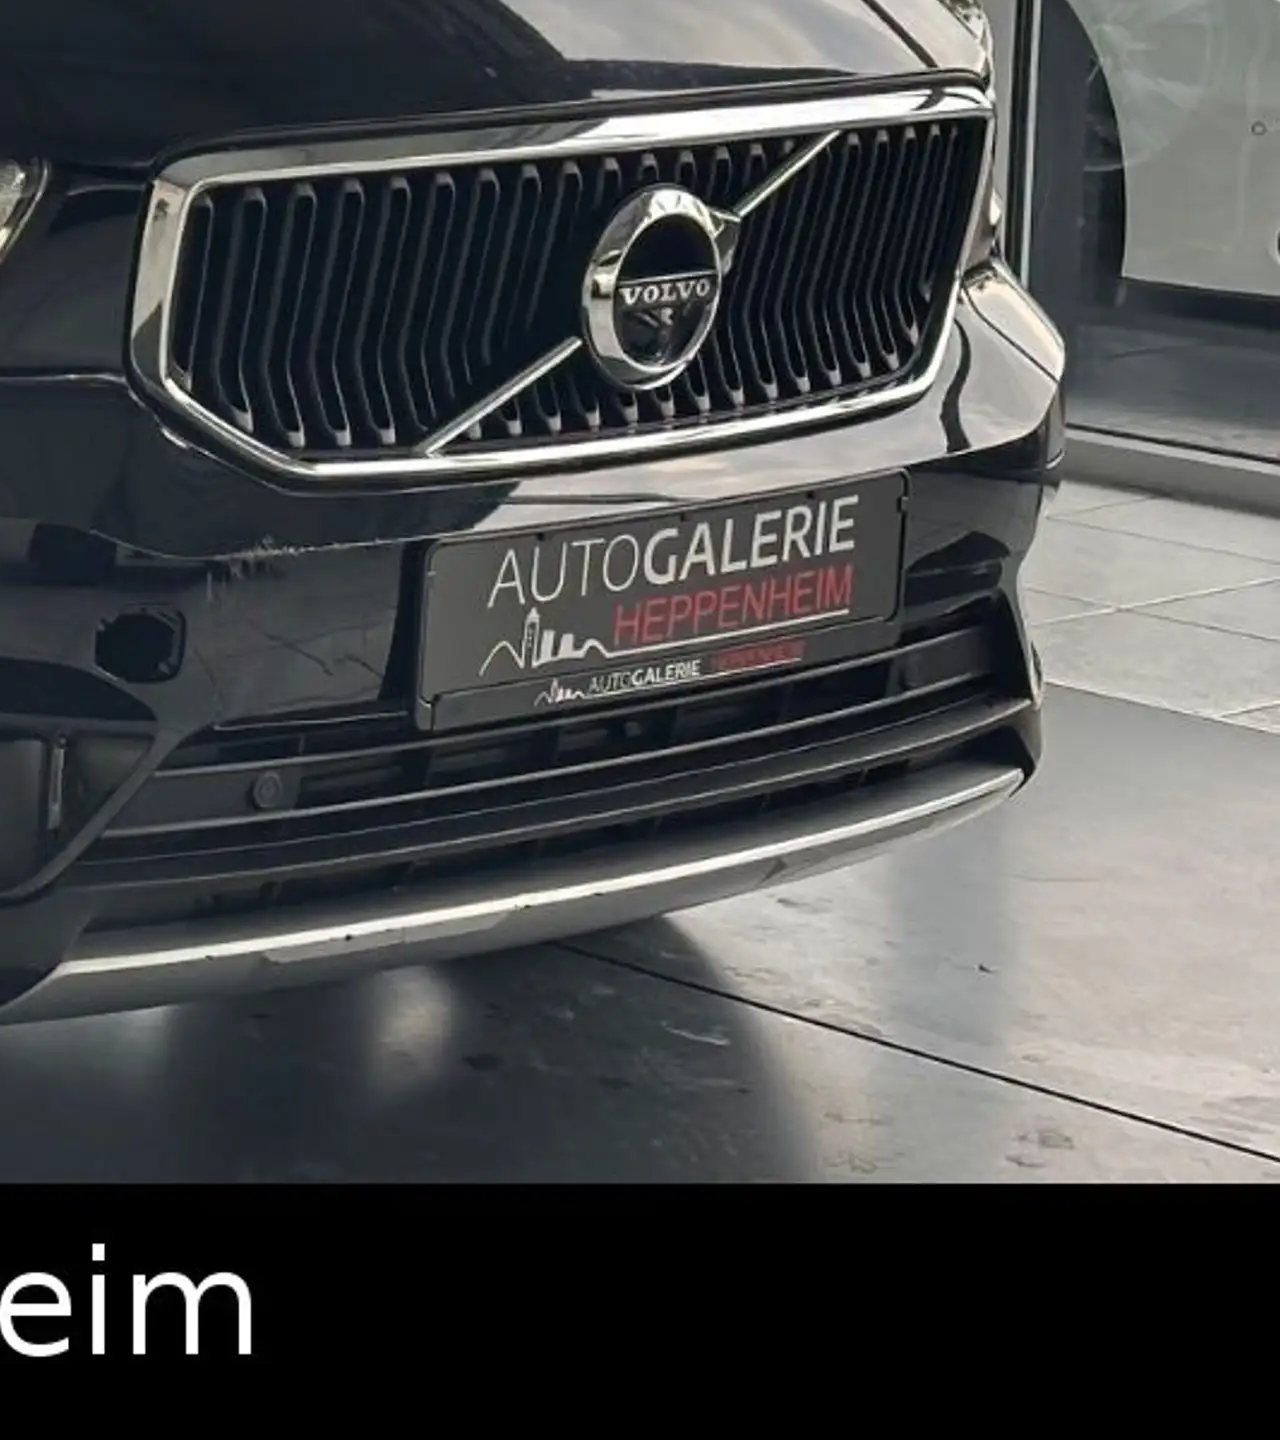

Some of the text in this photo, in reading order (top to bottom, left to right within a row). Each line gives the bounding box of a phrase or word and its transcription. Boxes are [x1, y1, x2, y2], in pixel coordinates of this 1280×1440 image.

[619, 278, 712, 306] VOLVO
[487, 493, 859, 608] AUTOGALERIE
[613, 564, 854, 647] HEPPENHEIM
